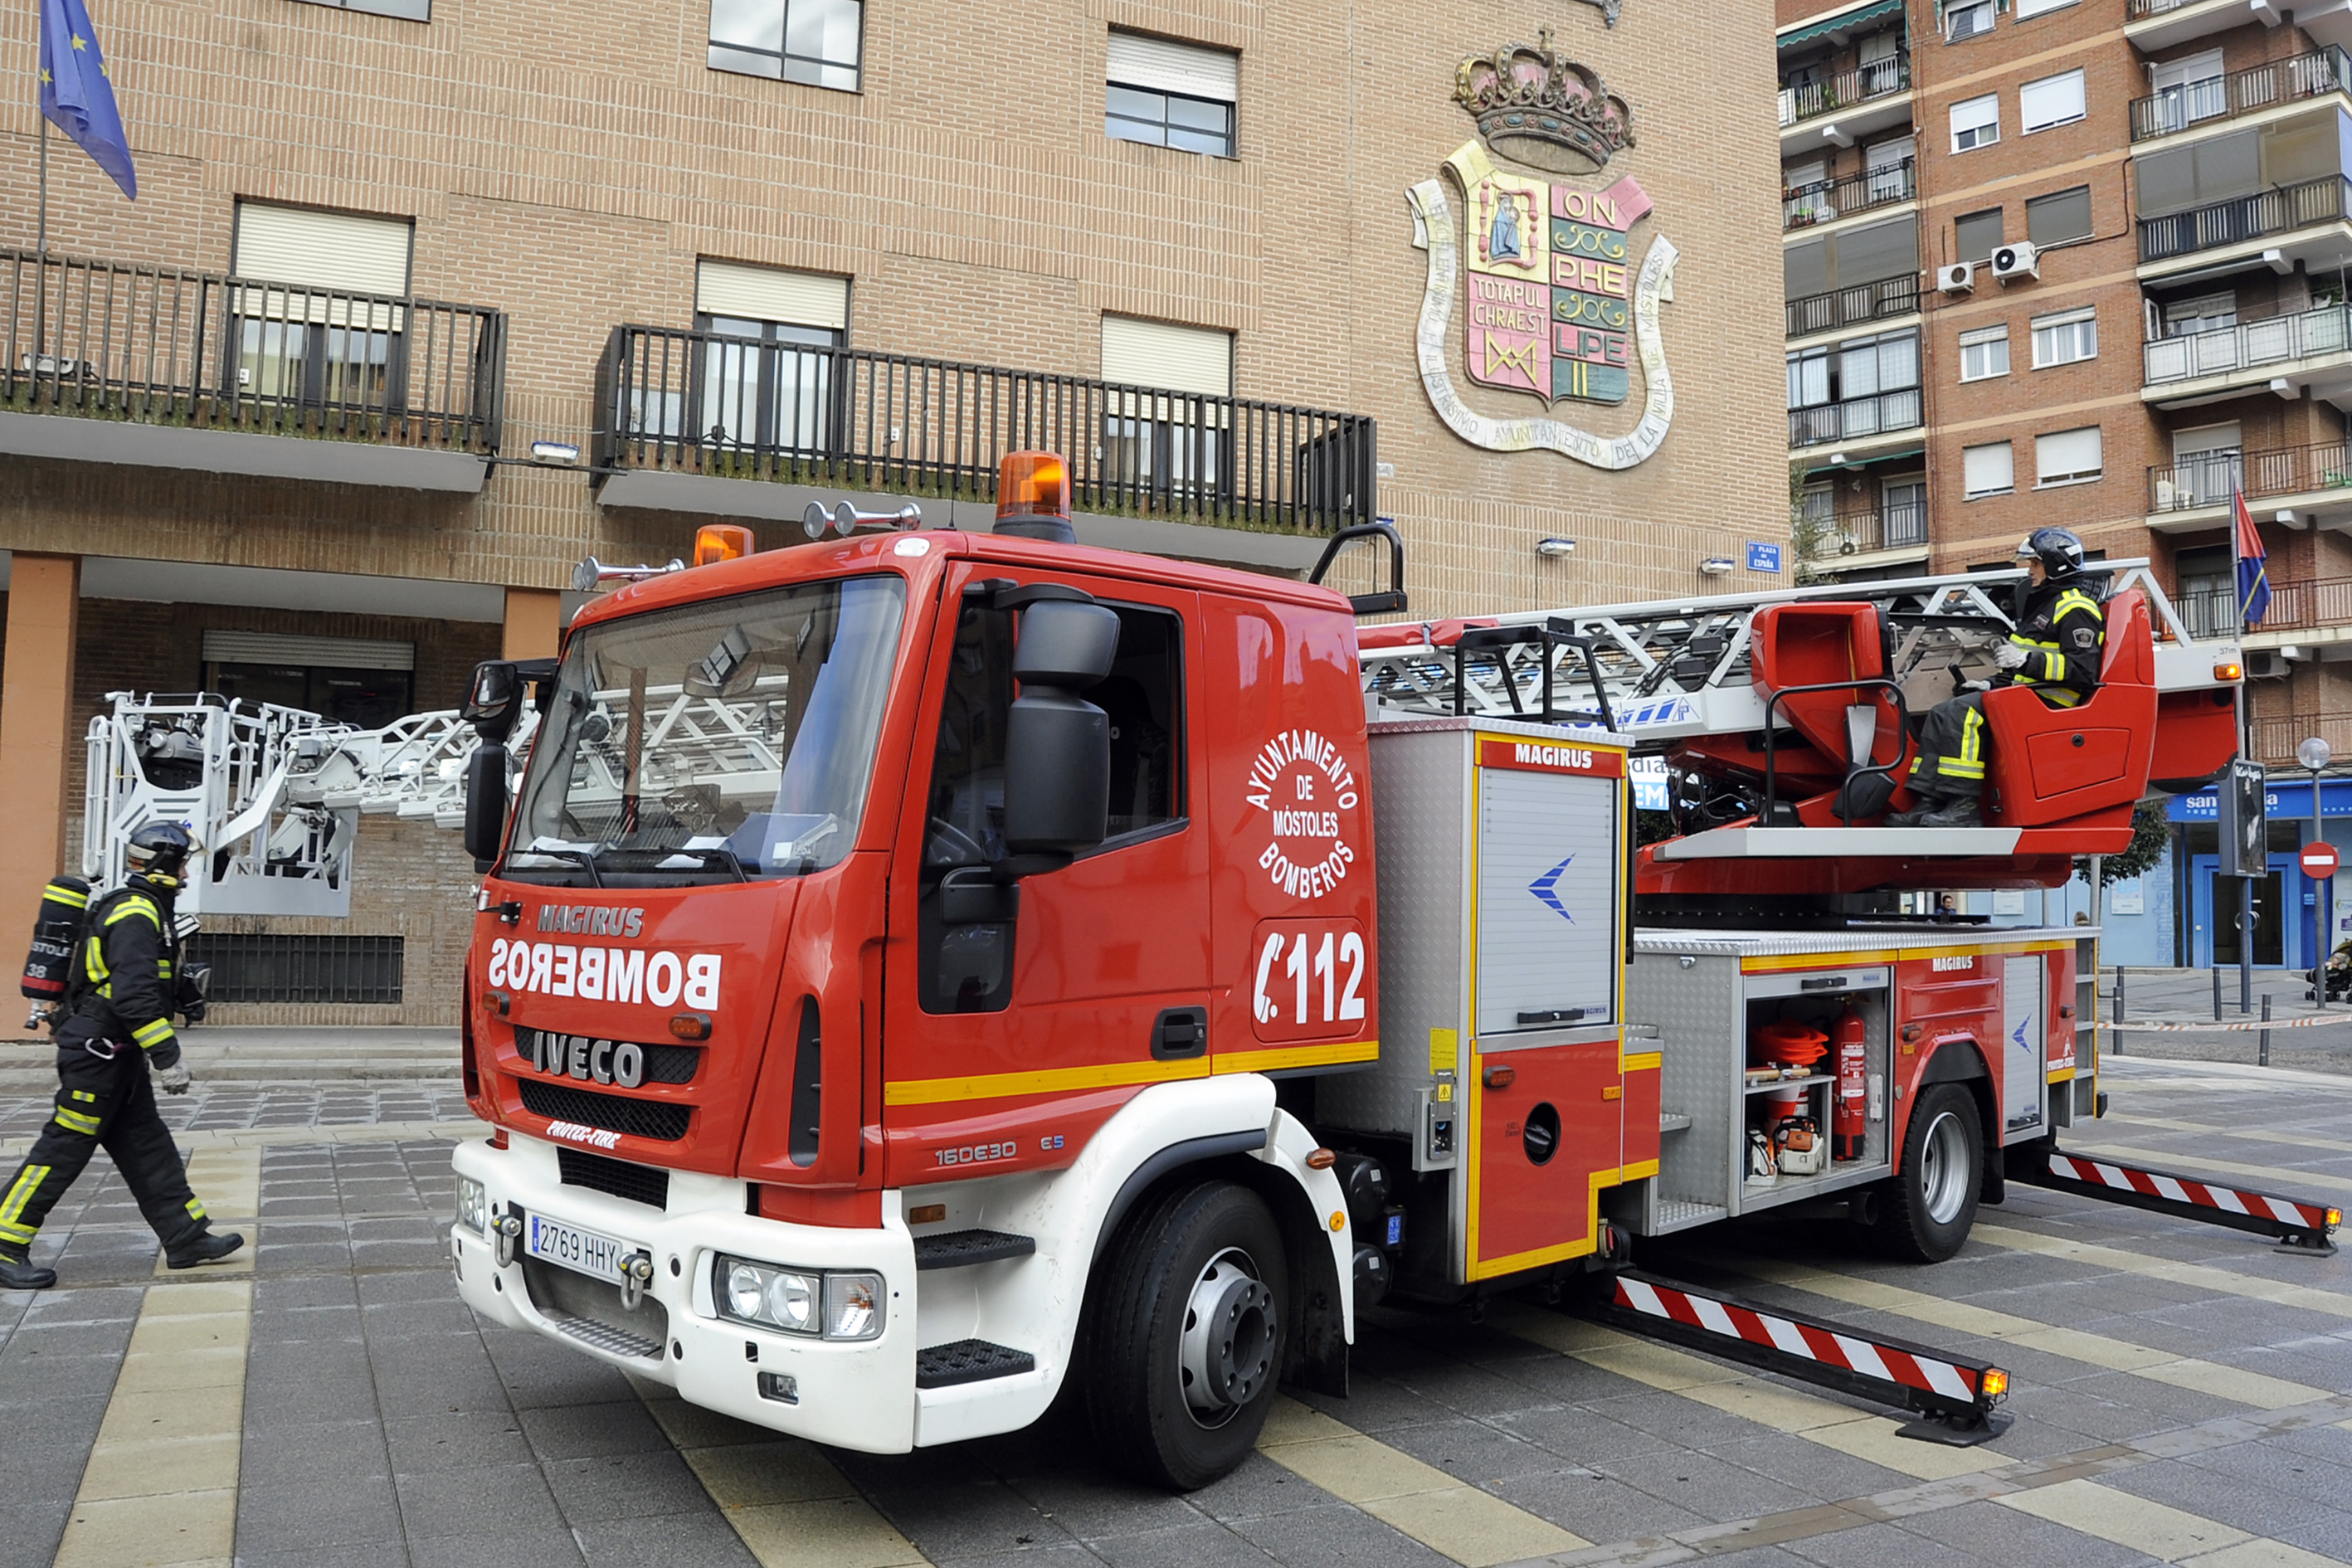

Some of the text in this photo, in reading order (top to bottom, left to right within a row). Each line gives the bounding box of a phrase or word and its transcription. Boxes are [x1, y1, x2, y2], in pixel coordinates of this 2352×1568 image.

[1565, 192, 1615, 226] ON
[1556, 255, 1625, 295] PHE
[1556, 326, 1626, 363] LIPE
[1647, 348, 1660, 365] DE
[1652, 377, 1667, 415] VILLA
[1494, 423, 1600, 456] AYUNTAMIENTO
[1615, 444, 1636, 460] DE
[1639, 426, 1658, 448] LA
[2218, 647, 2237, 655] 37m
[1246, 729, 1358, 811] AYUNTAMIENTO
[1515, 743, 1593, 769] MAGIRUS
[1296, 774, 1314, 801] DE
[1273, 805, 1339, 838] MÓSTOLES
[1259, 840, 1355, 899] BOMBEROS
[538, 904, 644, 937] MAGIRUS
[27, 963, 47, 979] 38
[1287, 932, 1365, 1024] 112
[1932, 955, 1974, 972] MAGIRUS
[533, 1031, 645, 1088] IVECO
[546, 1120, 622, 1150] PROTEC-FIRE
[934, 1135, 1064, 1166] 160E30 E5
[540, 1224, 579, 1261] 2769
[585, 1236, 616, 1273] HHY
